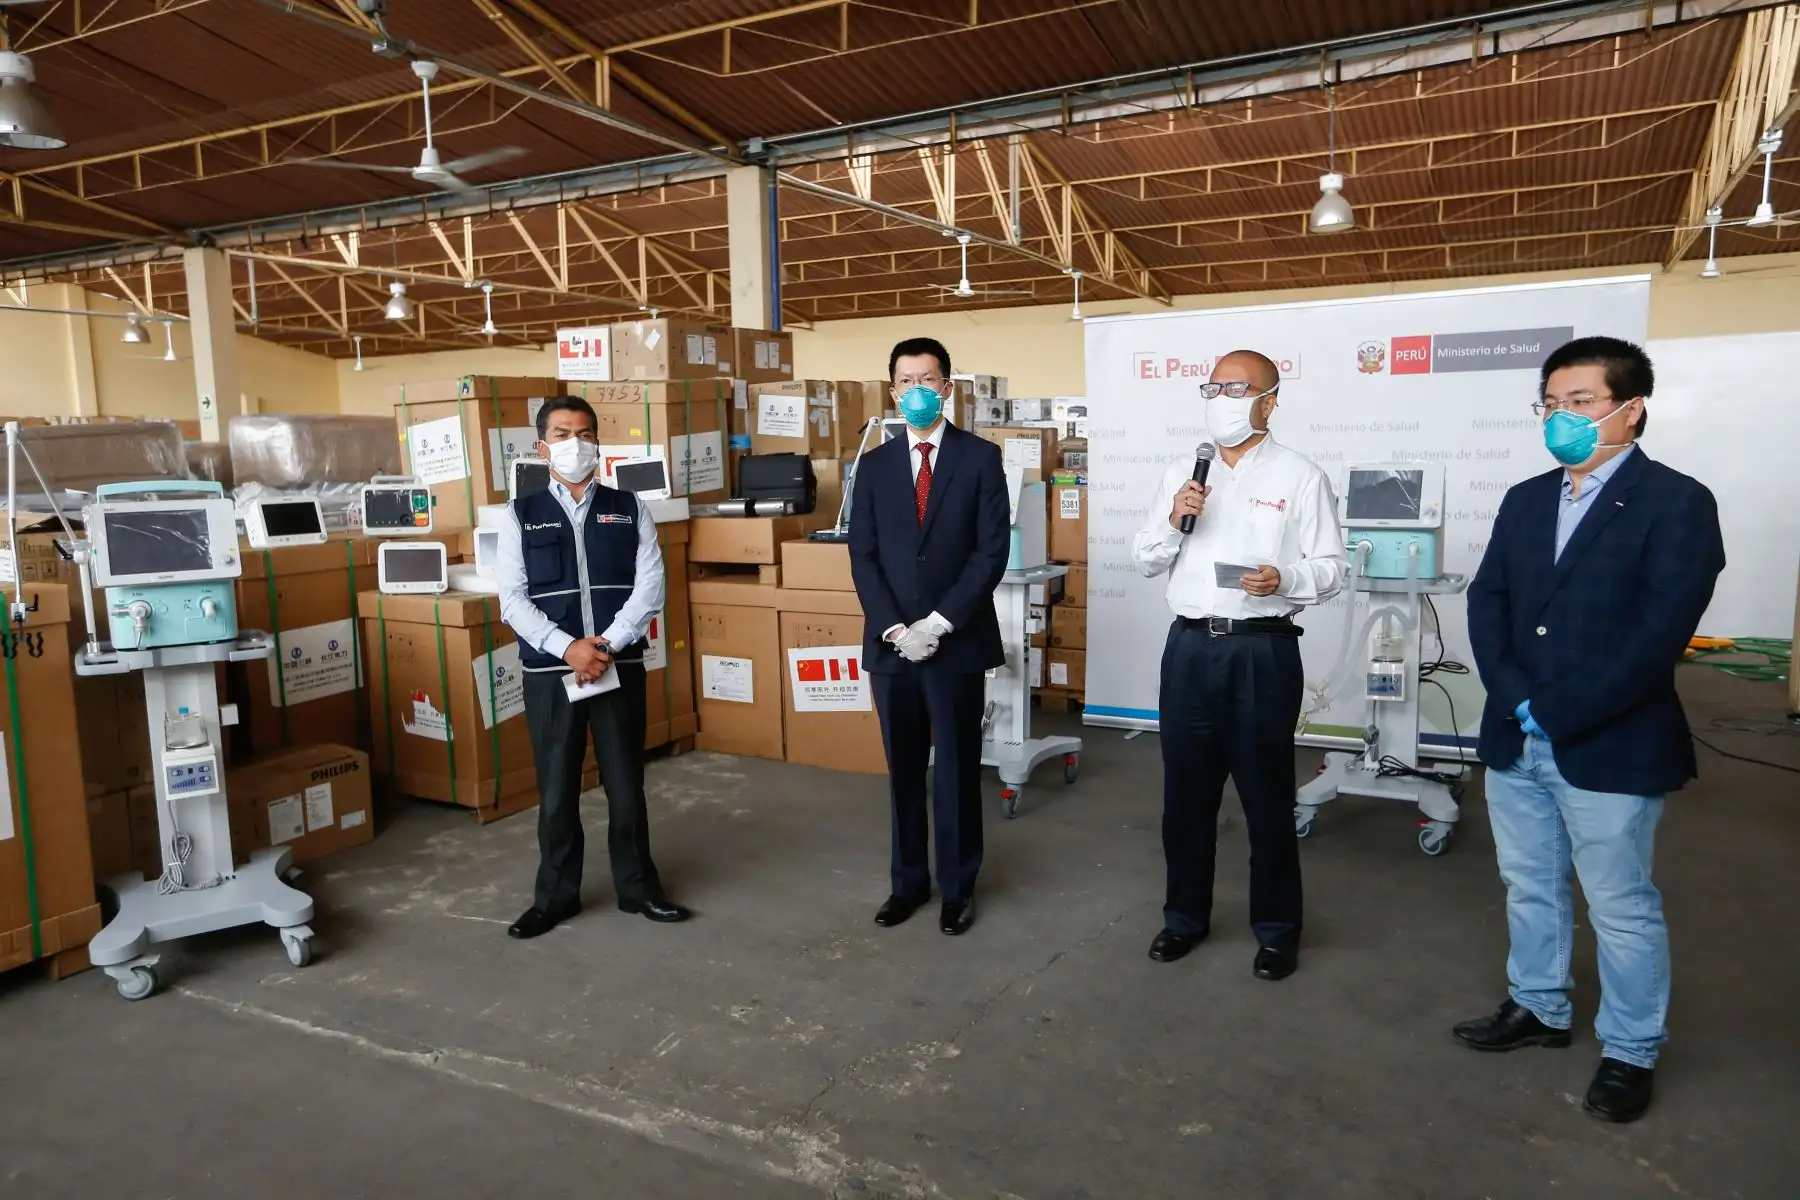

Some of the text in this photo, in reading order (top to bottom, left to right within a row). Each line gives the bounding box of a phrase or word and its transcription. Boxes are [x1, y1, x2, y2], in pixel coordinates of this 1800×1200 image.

[1395, 348, 1427, 361] PERÚ
[1438, 342, 1540, 359] Ministerio de Salud
[1140, 359, 1161, 379] EL
[1166, 357, 1209, 378] PERÚ
[1309, 419, 1420, 434] Ministerio de Salud
[1472, 418, 1537, 429] Ministerio
[1392, 447, 1510, 461] Ministerio de Salud
[1099, 534, 1126, 545] Salud
[1098, 586, 1126, 598] Salud
[310, 760, 360, 782] PHILIPS
